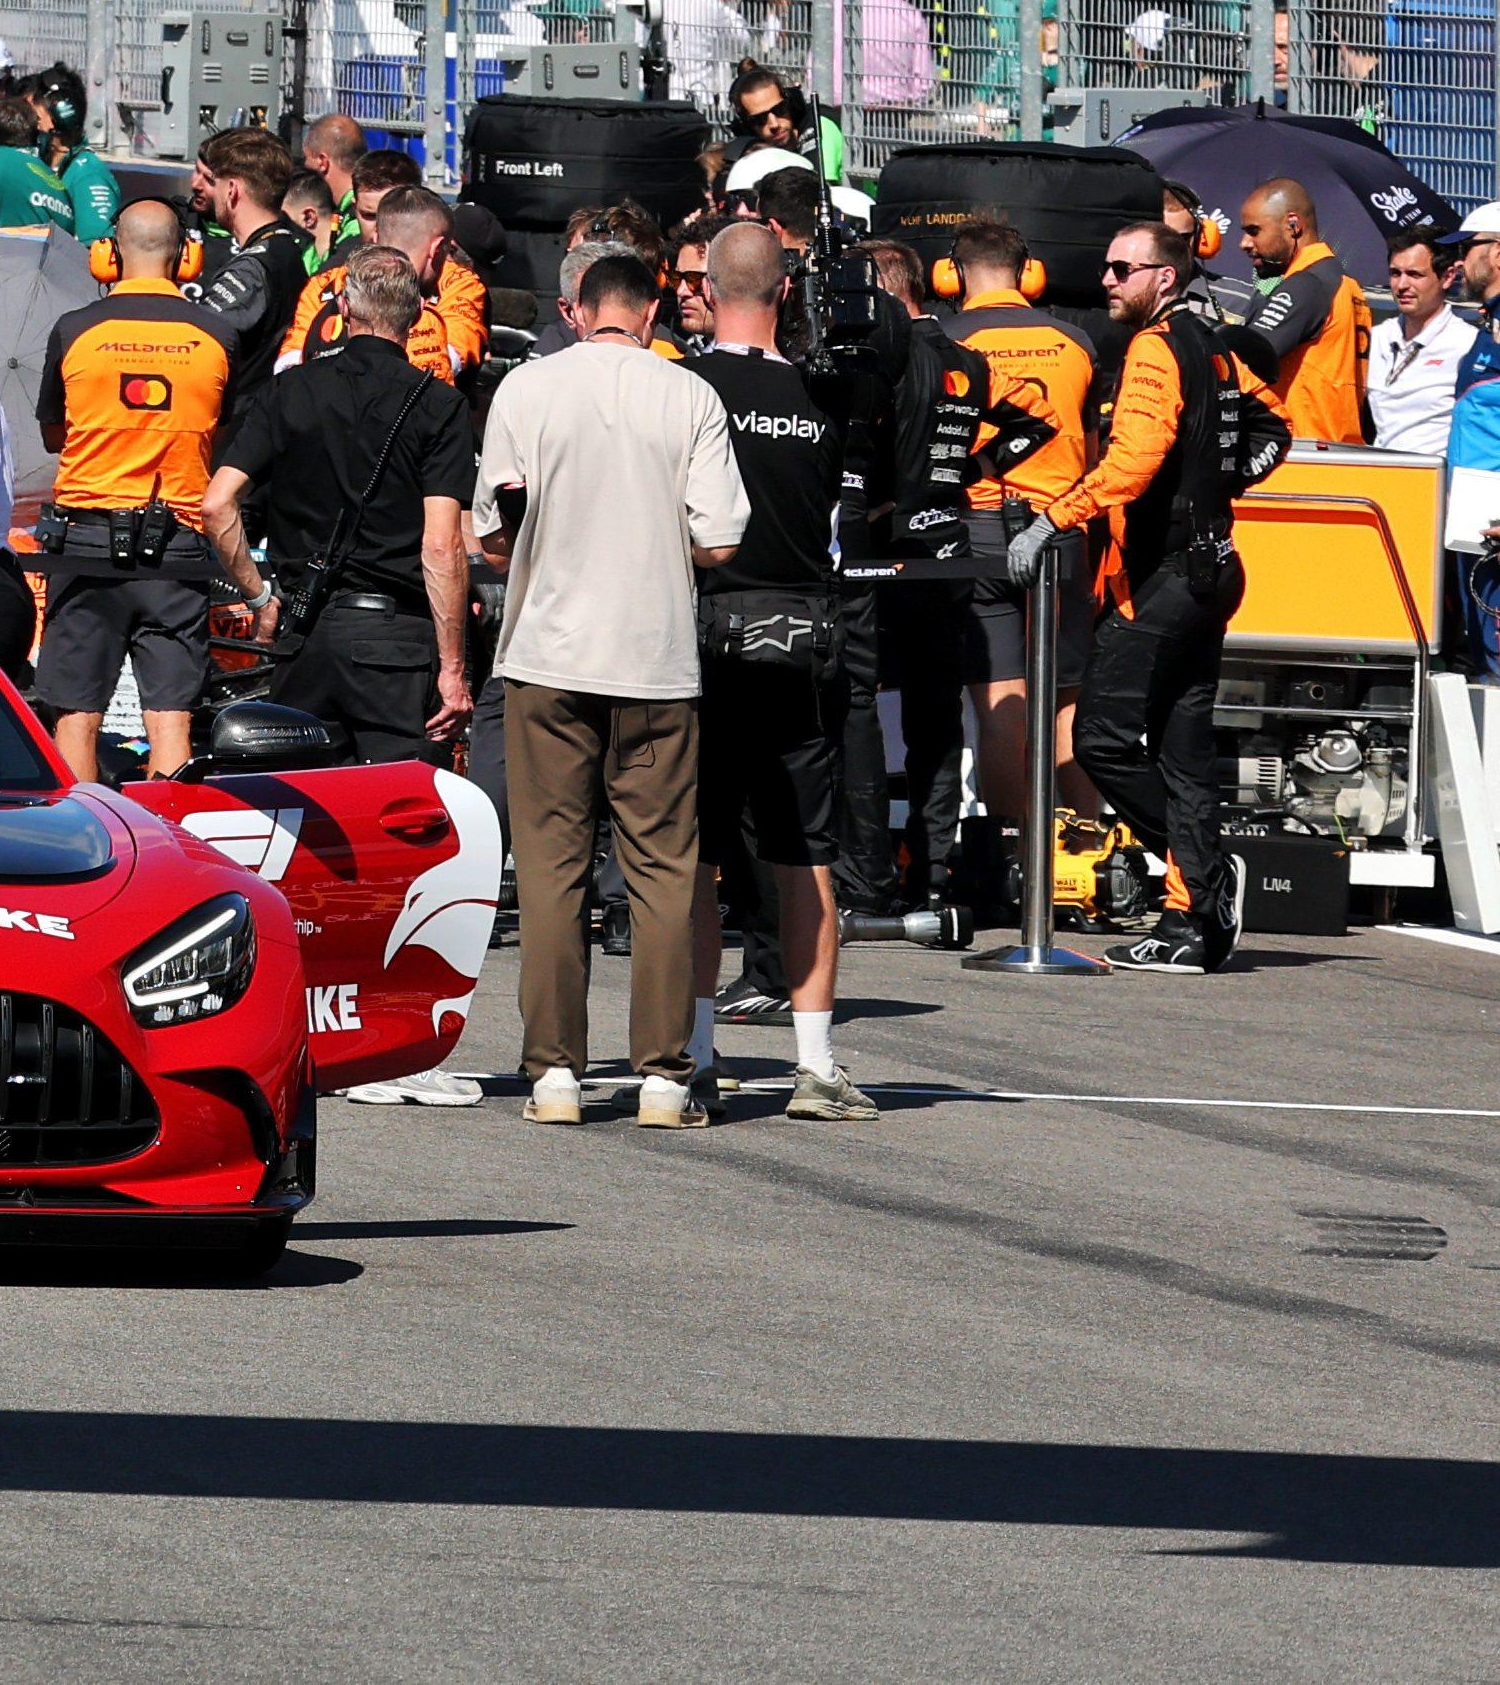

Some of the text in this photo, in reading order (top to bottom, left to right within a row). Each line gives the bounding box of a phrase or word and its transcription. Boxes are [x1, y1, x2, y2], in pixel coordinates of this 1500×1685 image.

[495, 159, 564, 178] Front Left
[94, 341, 192, 354] McLaren
[730, 409, 826, 444] viaplay
[1262, 876, 1293, 893] LN4
